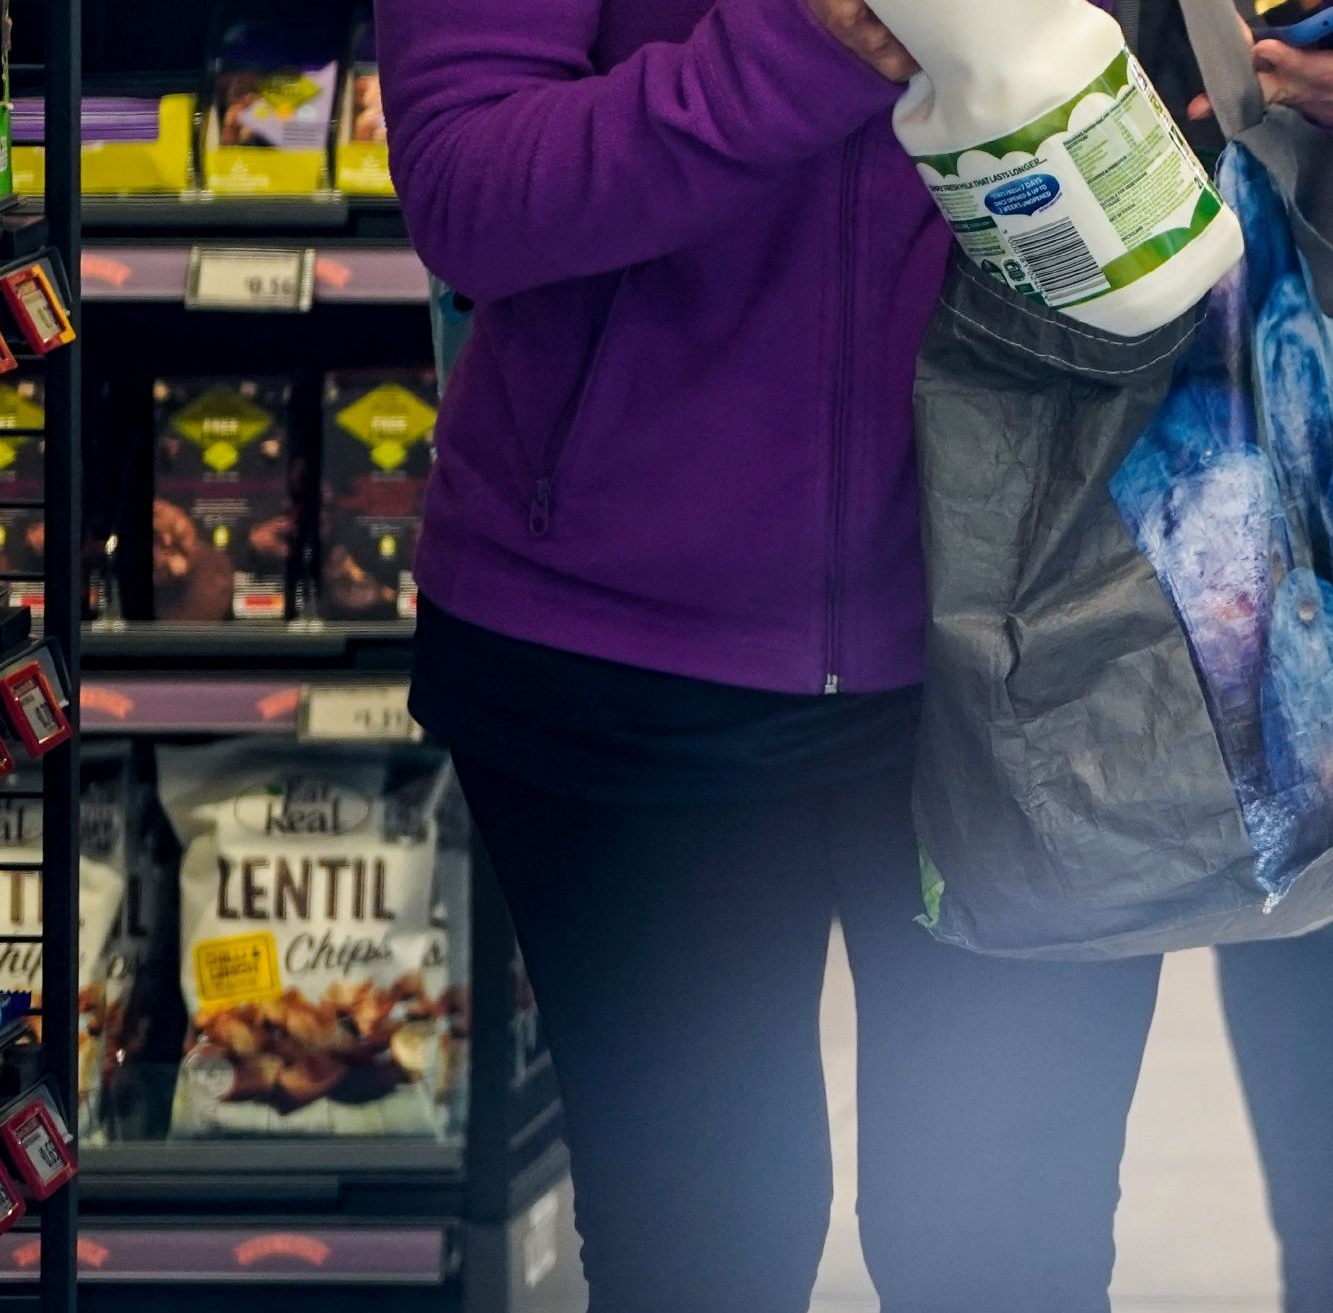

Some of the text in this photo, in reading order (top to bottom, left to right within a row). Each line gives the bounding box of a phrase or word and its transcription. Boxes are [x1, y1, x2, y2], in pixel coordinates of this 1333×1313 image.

[973, 177, 989, 188] THAT
[989, 171, 1010, 184] LASTS
[1025, 176, 1043, 190] DAYS
[1006, 192, 1027, 204] OPENED
[1031, 187, 1040, 196] UP
[1003, 202, 1021, 213] WEEKS
[266, 797, 340, 835] Real
[217, 854, 396, 921] LENTIL
[285, 928, 393, 974] Chips
